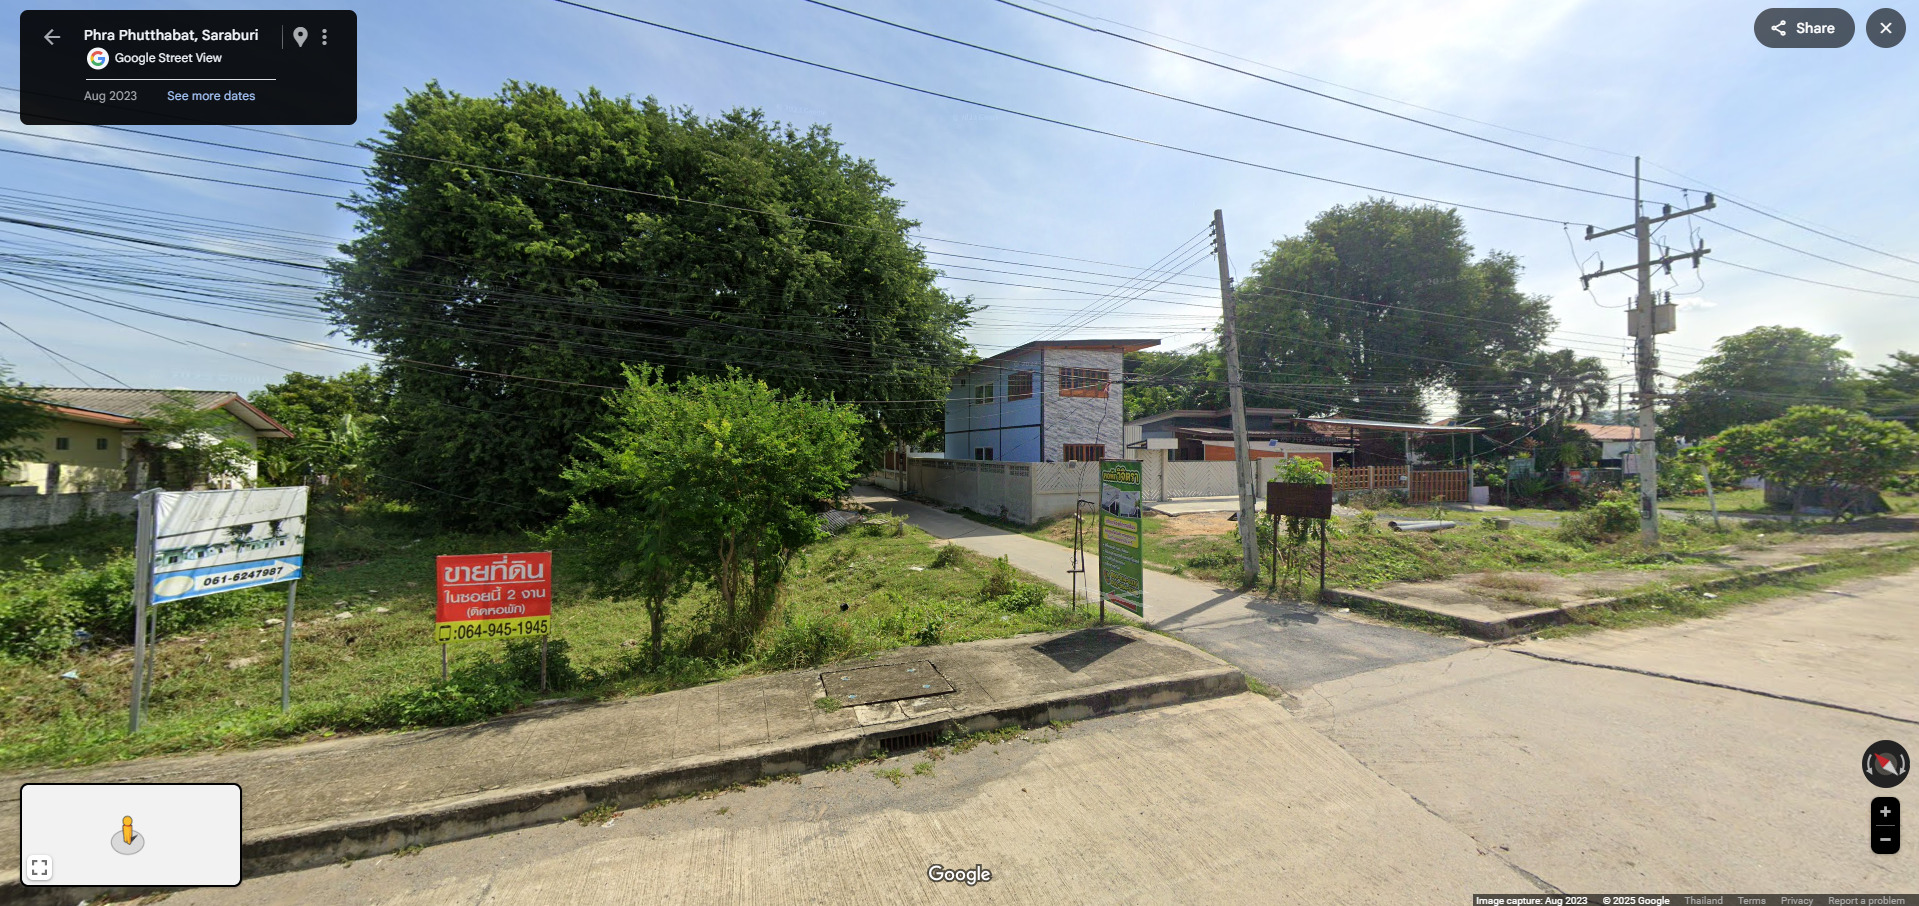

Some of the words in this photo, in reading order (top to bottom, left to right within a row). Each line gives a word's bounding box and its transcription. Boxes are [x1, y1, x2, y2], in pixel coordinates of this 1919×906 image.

[203, 566, 284, 587] 061-6247987
[444, 555, 544, 583] ขายที่ดิน
[443, 586, 502, 604] ในซอยนี้
[507, 589, 516, 600] 2
[521, 588, 546, 599] งาน
[466, 604, 526, 618] (ติดหอพัก)
